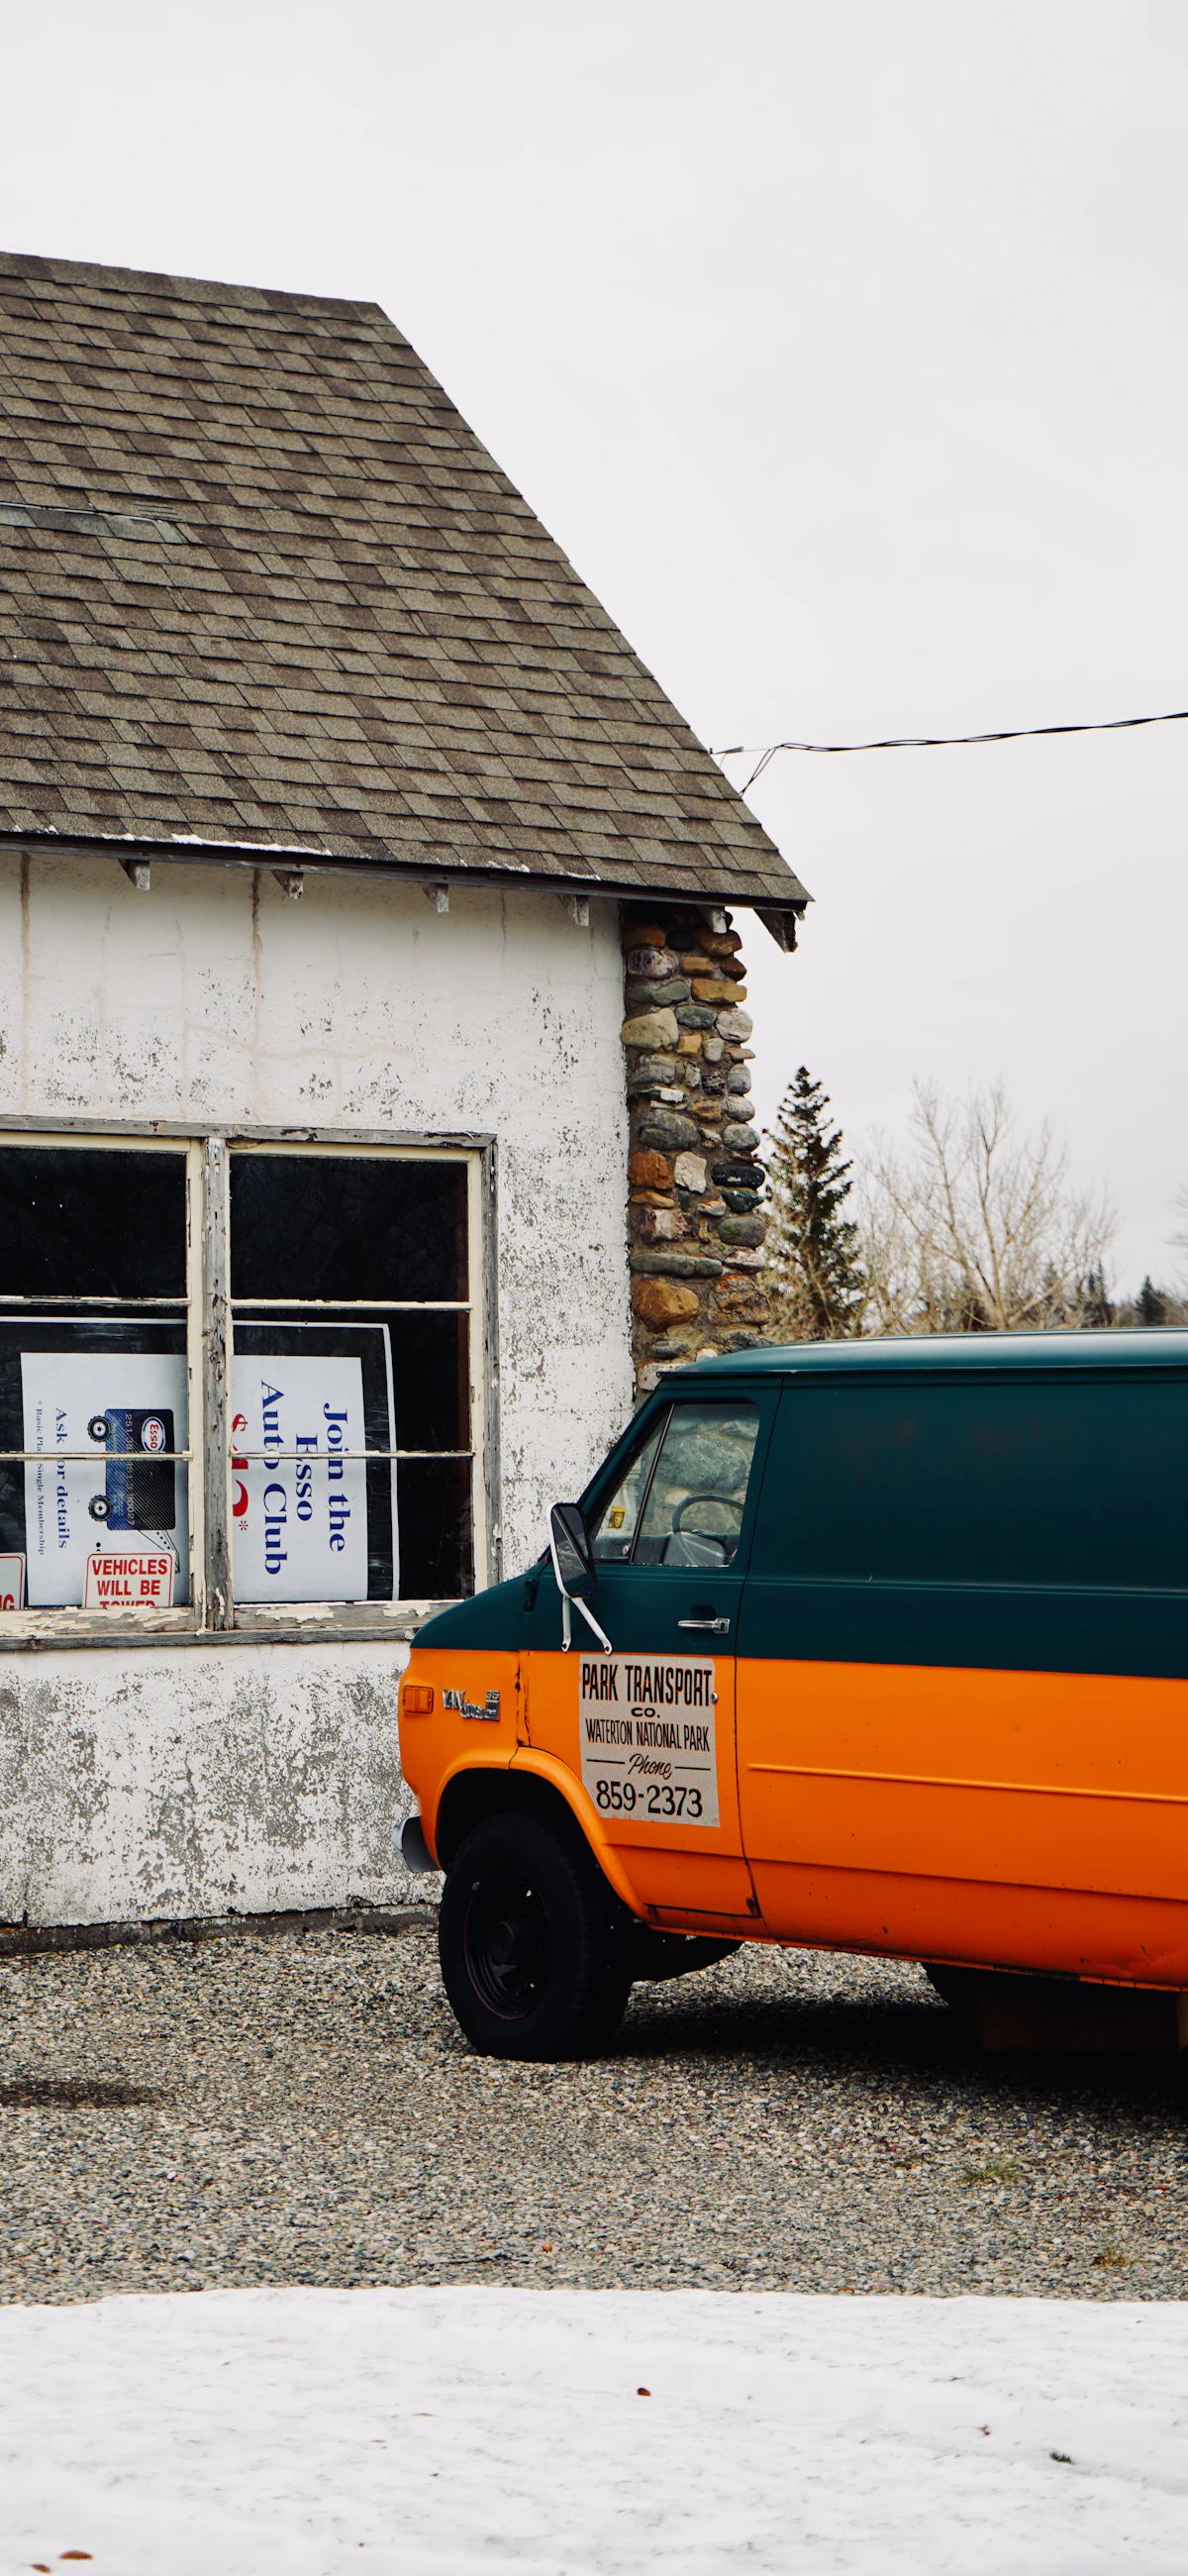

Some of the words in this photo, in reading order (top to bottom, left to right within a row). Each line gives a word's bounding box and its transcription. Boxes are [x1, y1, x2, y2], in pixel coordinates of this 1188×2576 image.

[55, 1407, 68, 1444] Ask
[261, 1380, 284, 1471] Auto
[323, 1402, 348, 1482] Join
[56, 1453, 66, 1481] or
[295, 1433, 318, 1521] Esso
[37, 1494, 46, 1556] Membership
[56, 1485, 70, 1549] details
[263, 1483, 288, 1575] Club
[328, 1493, 350, 1552] the
[92, 1559, 168, 1576] VEHICLES
[97, 1580, 132, 1597] WILL
[140, 1580, 161, 1596] BE
[582, 1663, 618, 1701] PARK
[625, 1665, 713, 1707] TRANSPORT
[585, 1718, 633, 1746] WATERTON
[636, 1721, 684, 1750] NATIONAL
[684, 1724, 711, 1752] PARK
[628, 1753, 672, 1781] Phone
[596, 1780, 703, 1818] 859-2373
